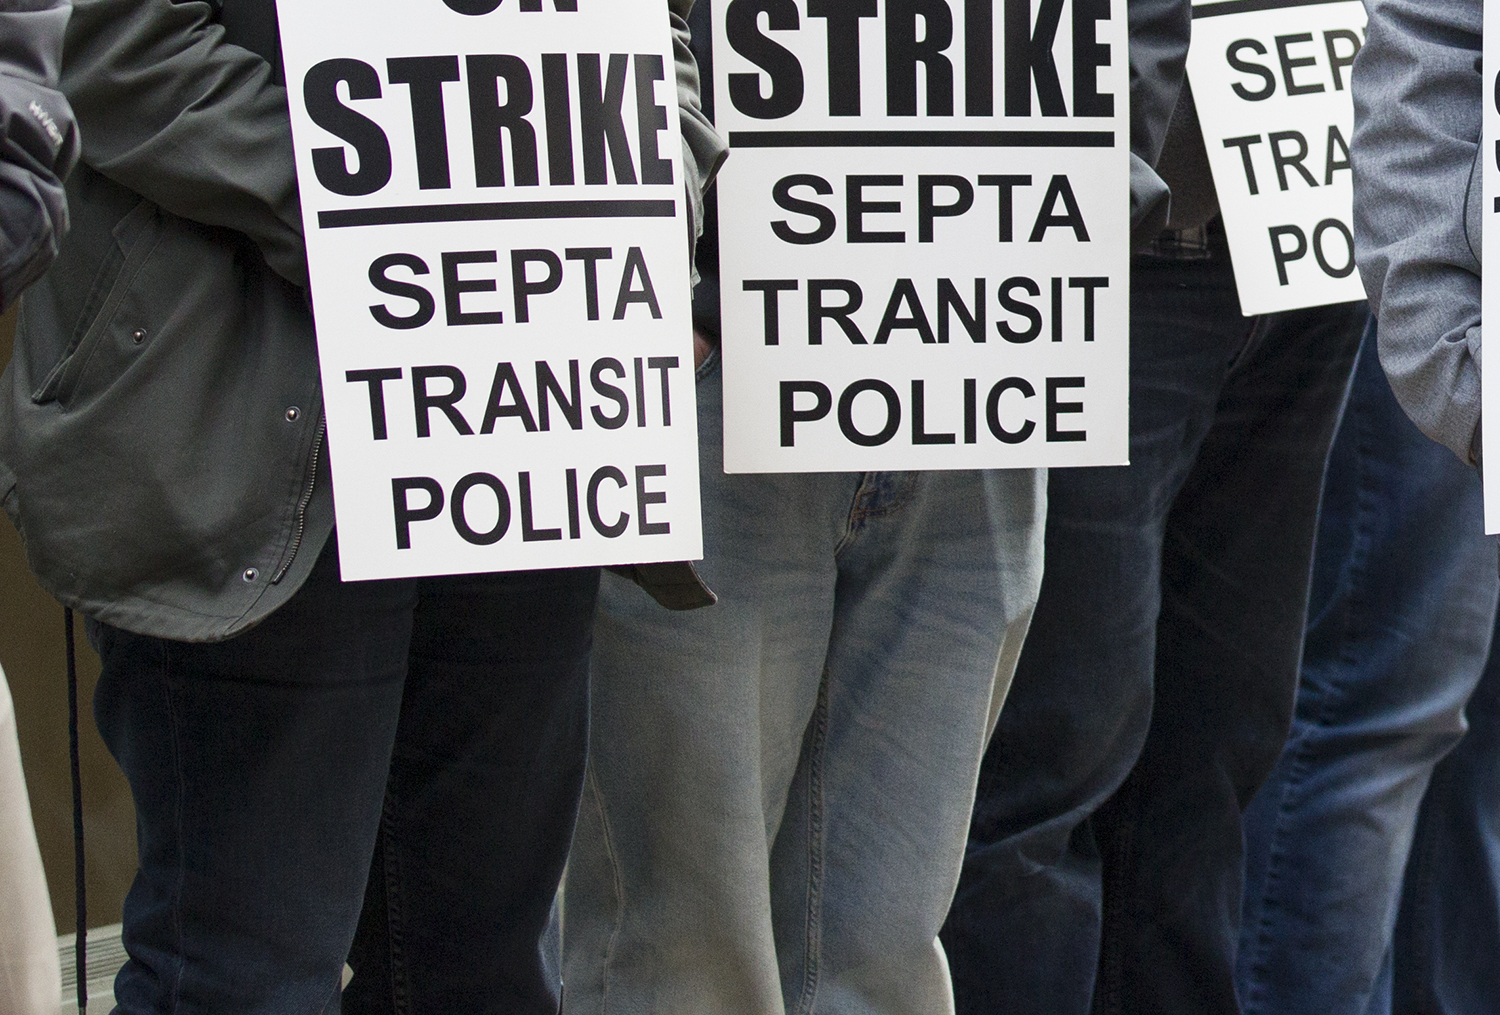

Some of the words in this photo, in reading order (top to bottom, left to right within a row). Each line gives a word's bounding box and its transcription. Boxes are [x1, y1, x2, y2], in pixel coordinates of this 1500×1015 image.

[1226, 27, 1367, 102] SEP
[304, 54, 674, 196] STRIKE
[1222, 125, 1352, 196] TRA
[771, 173, 1090, 244] SEPTA
[369, 246, 662, 329] SEPTA
[1268, 218, 1357, 286] PO
[743, 276, 1109, 346] TRANSIT
[346, 356, 680, 440] TRANSIT
[780, 377, 1086, 447] POLICE
[392, 465, 671, 550] POLICE
